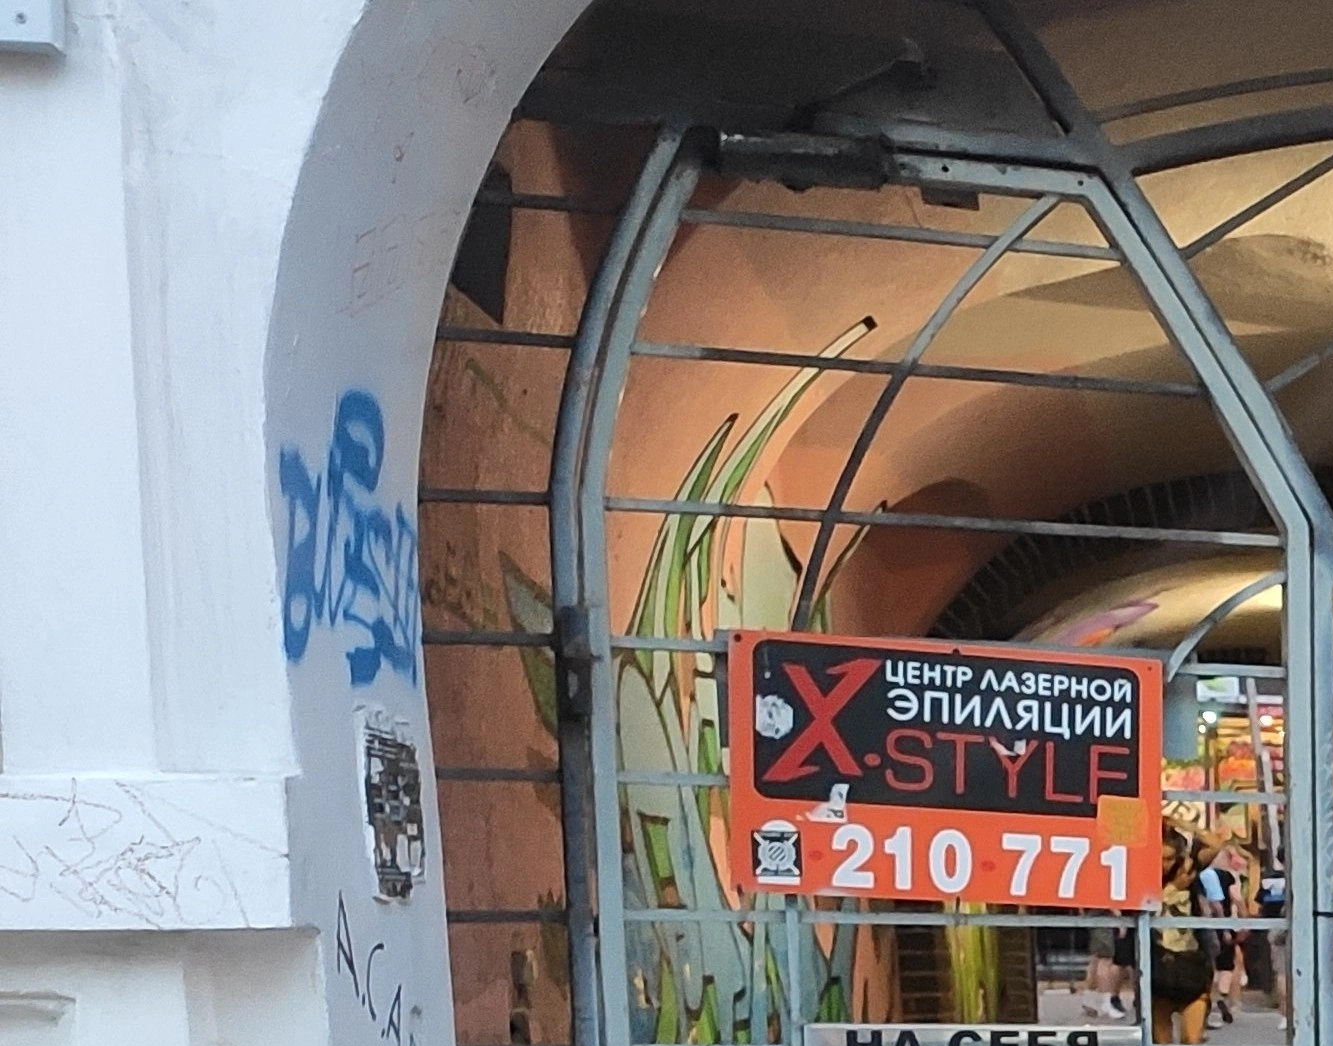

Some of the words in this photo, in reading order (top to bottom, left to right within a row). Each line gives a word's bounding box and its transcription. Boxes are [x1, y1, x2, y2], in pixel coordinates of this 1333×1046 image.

[885, 659, 973, 688] ЦЕНТР
[980, 668, 1132, 704] ЛАЗЕРНОЙ
[886, 688, 1132, 740] ЭПИЛЯЦИИ
[831, 823, 973, 894] 210
[1001, 832, 1128, 901] 771
